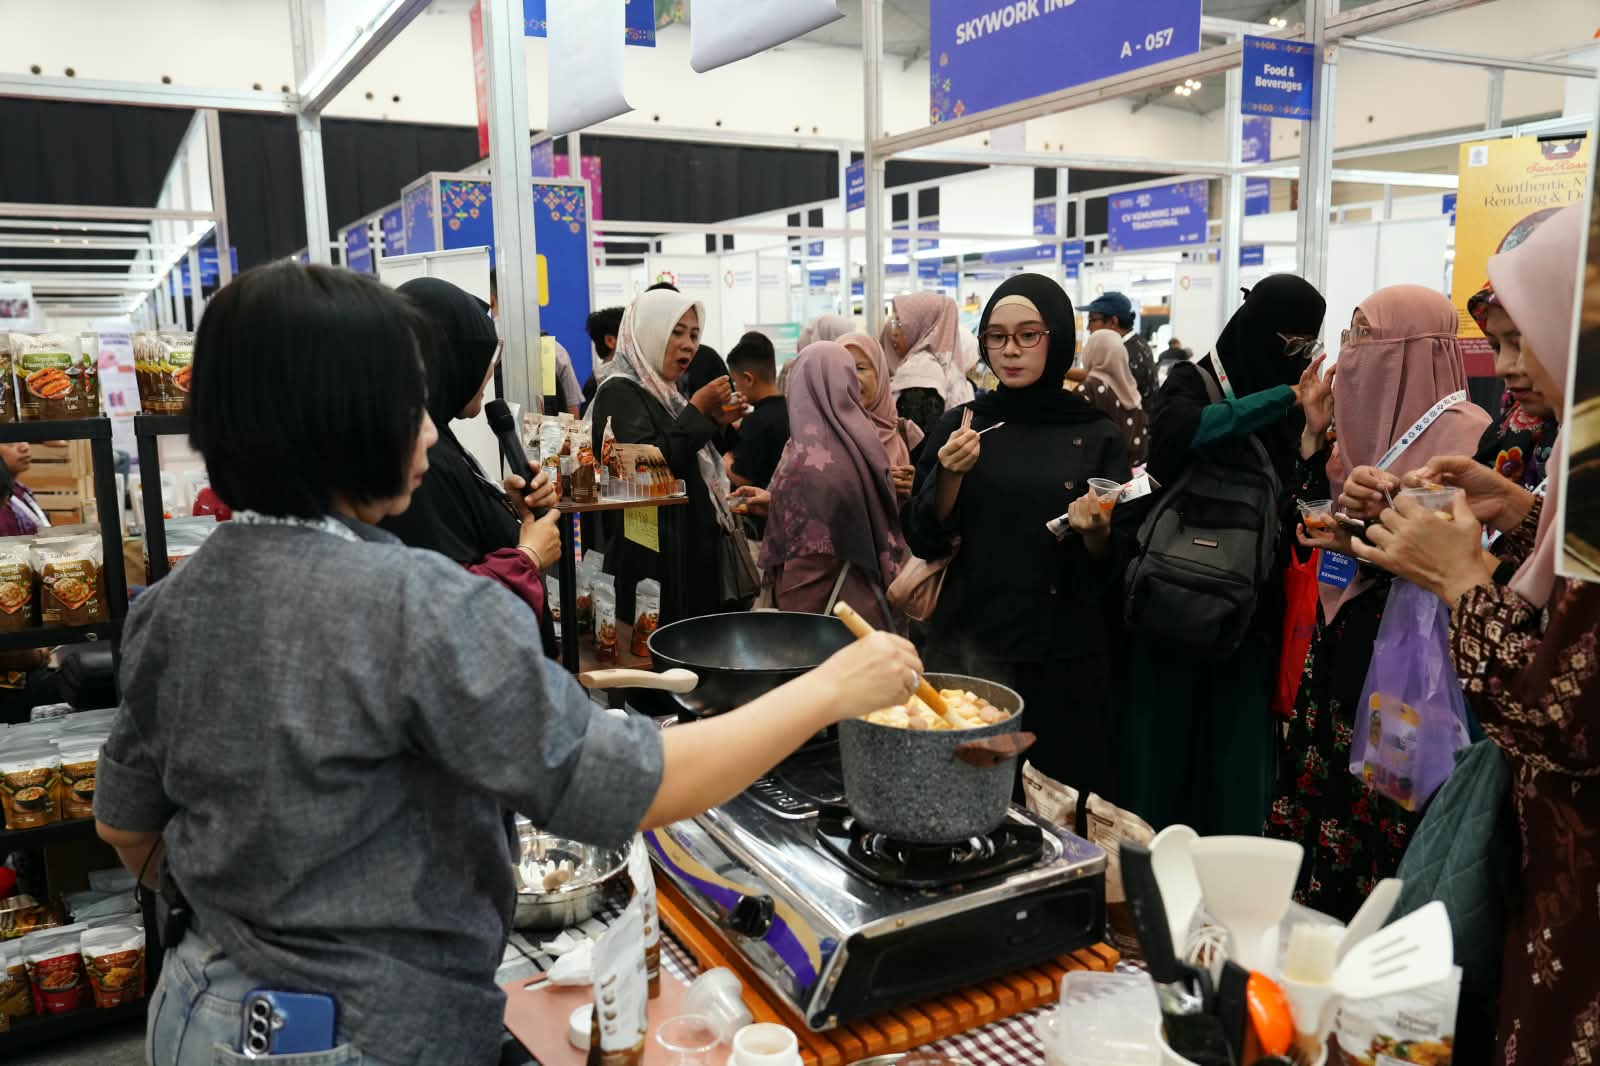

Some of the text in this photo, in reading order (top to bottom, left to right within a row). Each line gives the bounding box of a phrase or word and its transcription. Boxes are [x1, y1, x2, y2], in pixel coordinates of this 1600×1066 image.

[956, 0, 1040, 45] SKYWORK
[1120, 42, 1132, 59] A
[1145, 28, 1173, 52] 057
[1264, 64, 1295, 78] Food &
[1255, 76, 1303, 93] Beverages
[1484, 192, 1547, 208] Rendang
[1550, 191, 1562, 203] &
